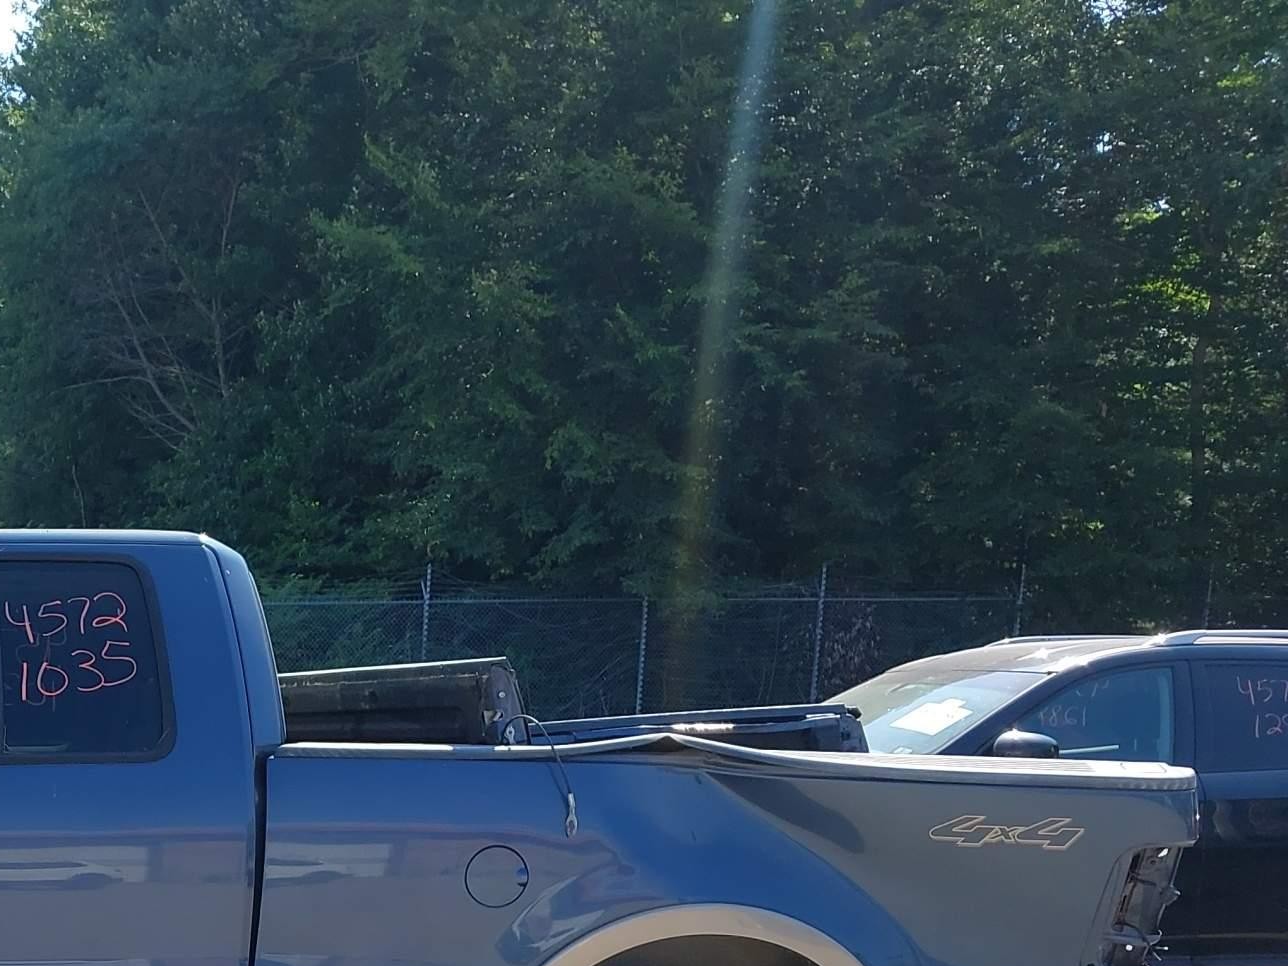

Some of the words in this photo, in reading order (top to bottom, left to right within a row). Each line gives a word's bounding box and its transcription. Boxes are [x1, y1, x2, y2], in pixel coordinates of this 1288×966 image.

[4, 592, 128, 643] 4572
[21, 640, 137, 701] 1035
[929, 815, 1085, 850] 4x4
